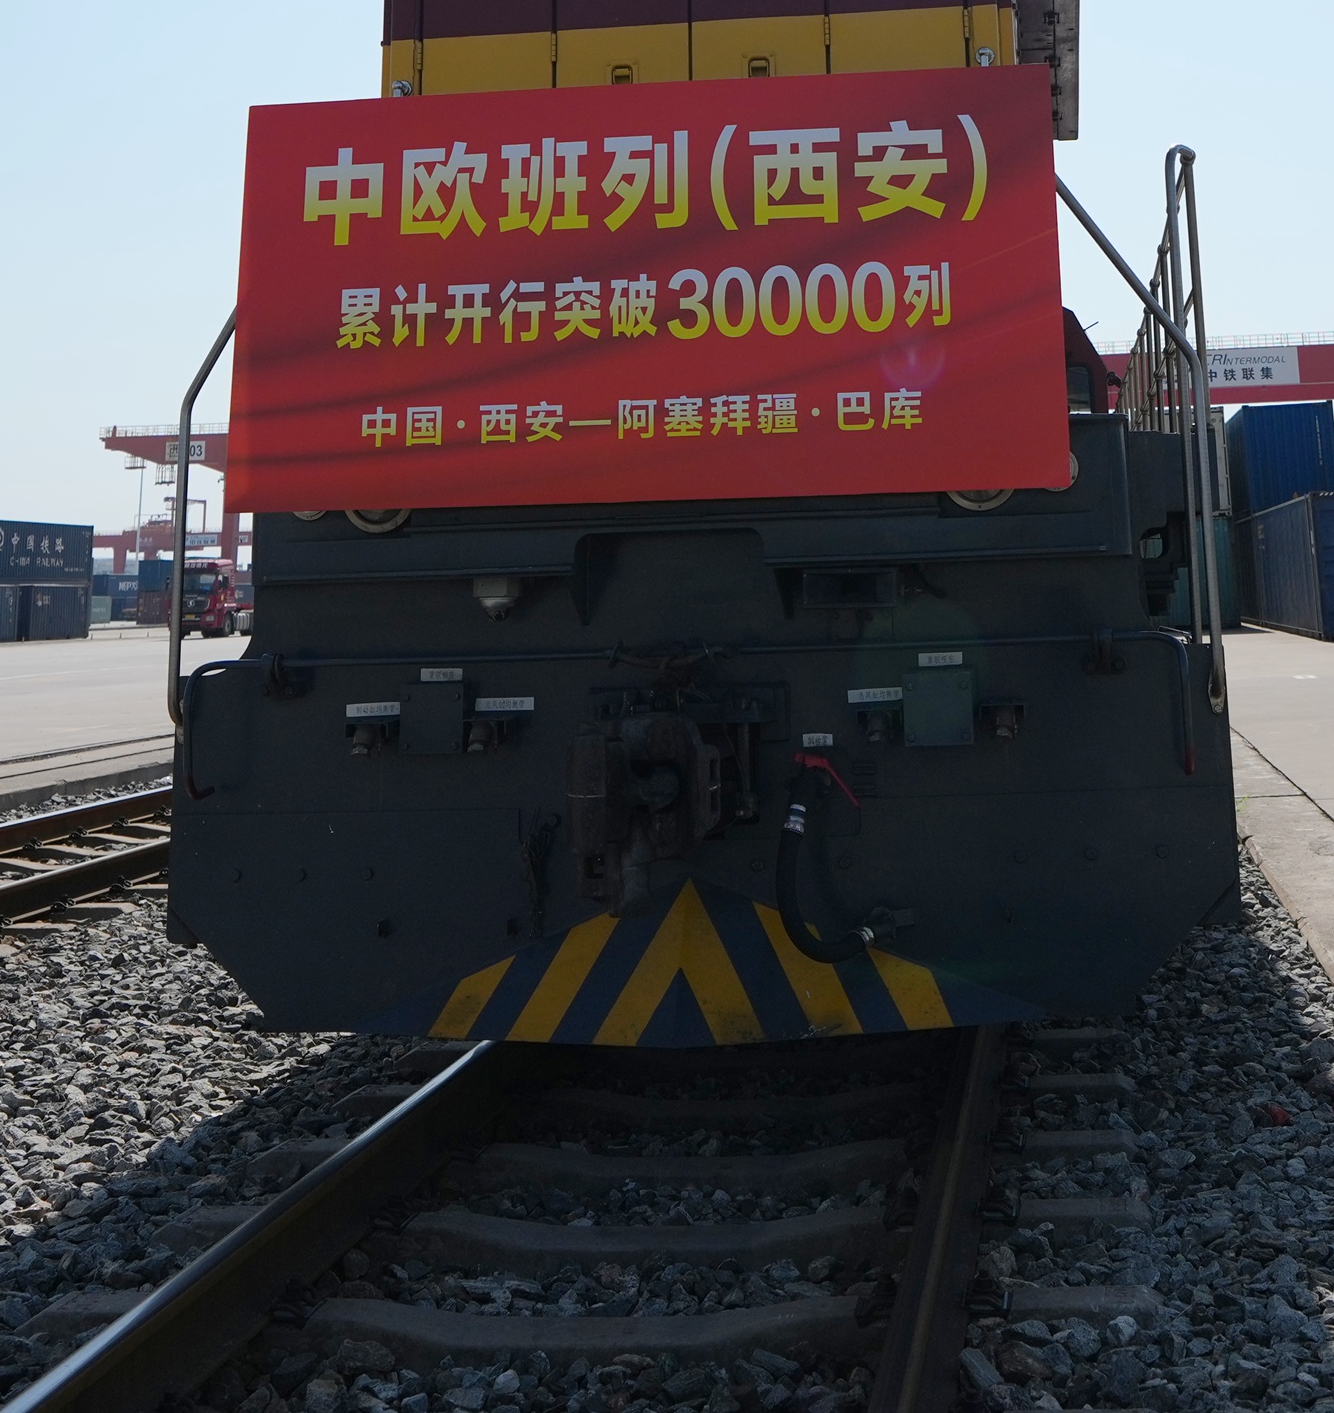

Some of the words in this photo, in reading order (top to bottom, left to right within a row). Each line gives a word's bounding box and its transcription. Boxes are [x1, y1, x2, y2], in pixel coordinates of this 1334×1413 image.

[302, 114, 988, 246] 中欧班列(西安)
[336, 261, 952, 349] 累计开行突破30000列
[1208, 366, 1273, 382] 中铁联集
[11, 533, 65, 554] 中国铁路
[36, 557, 64, 567] RAILWAY
